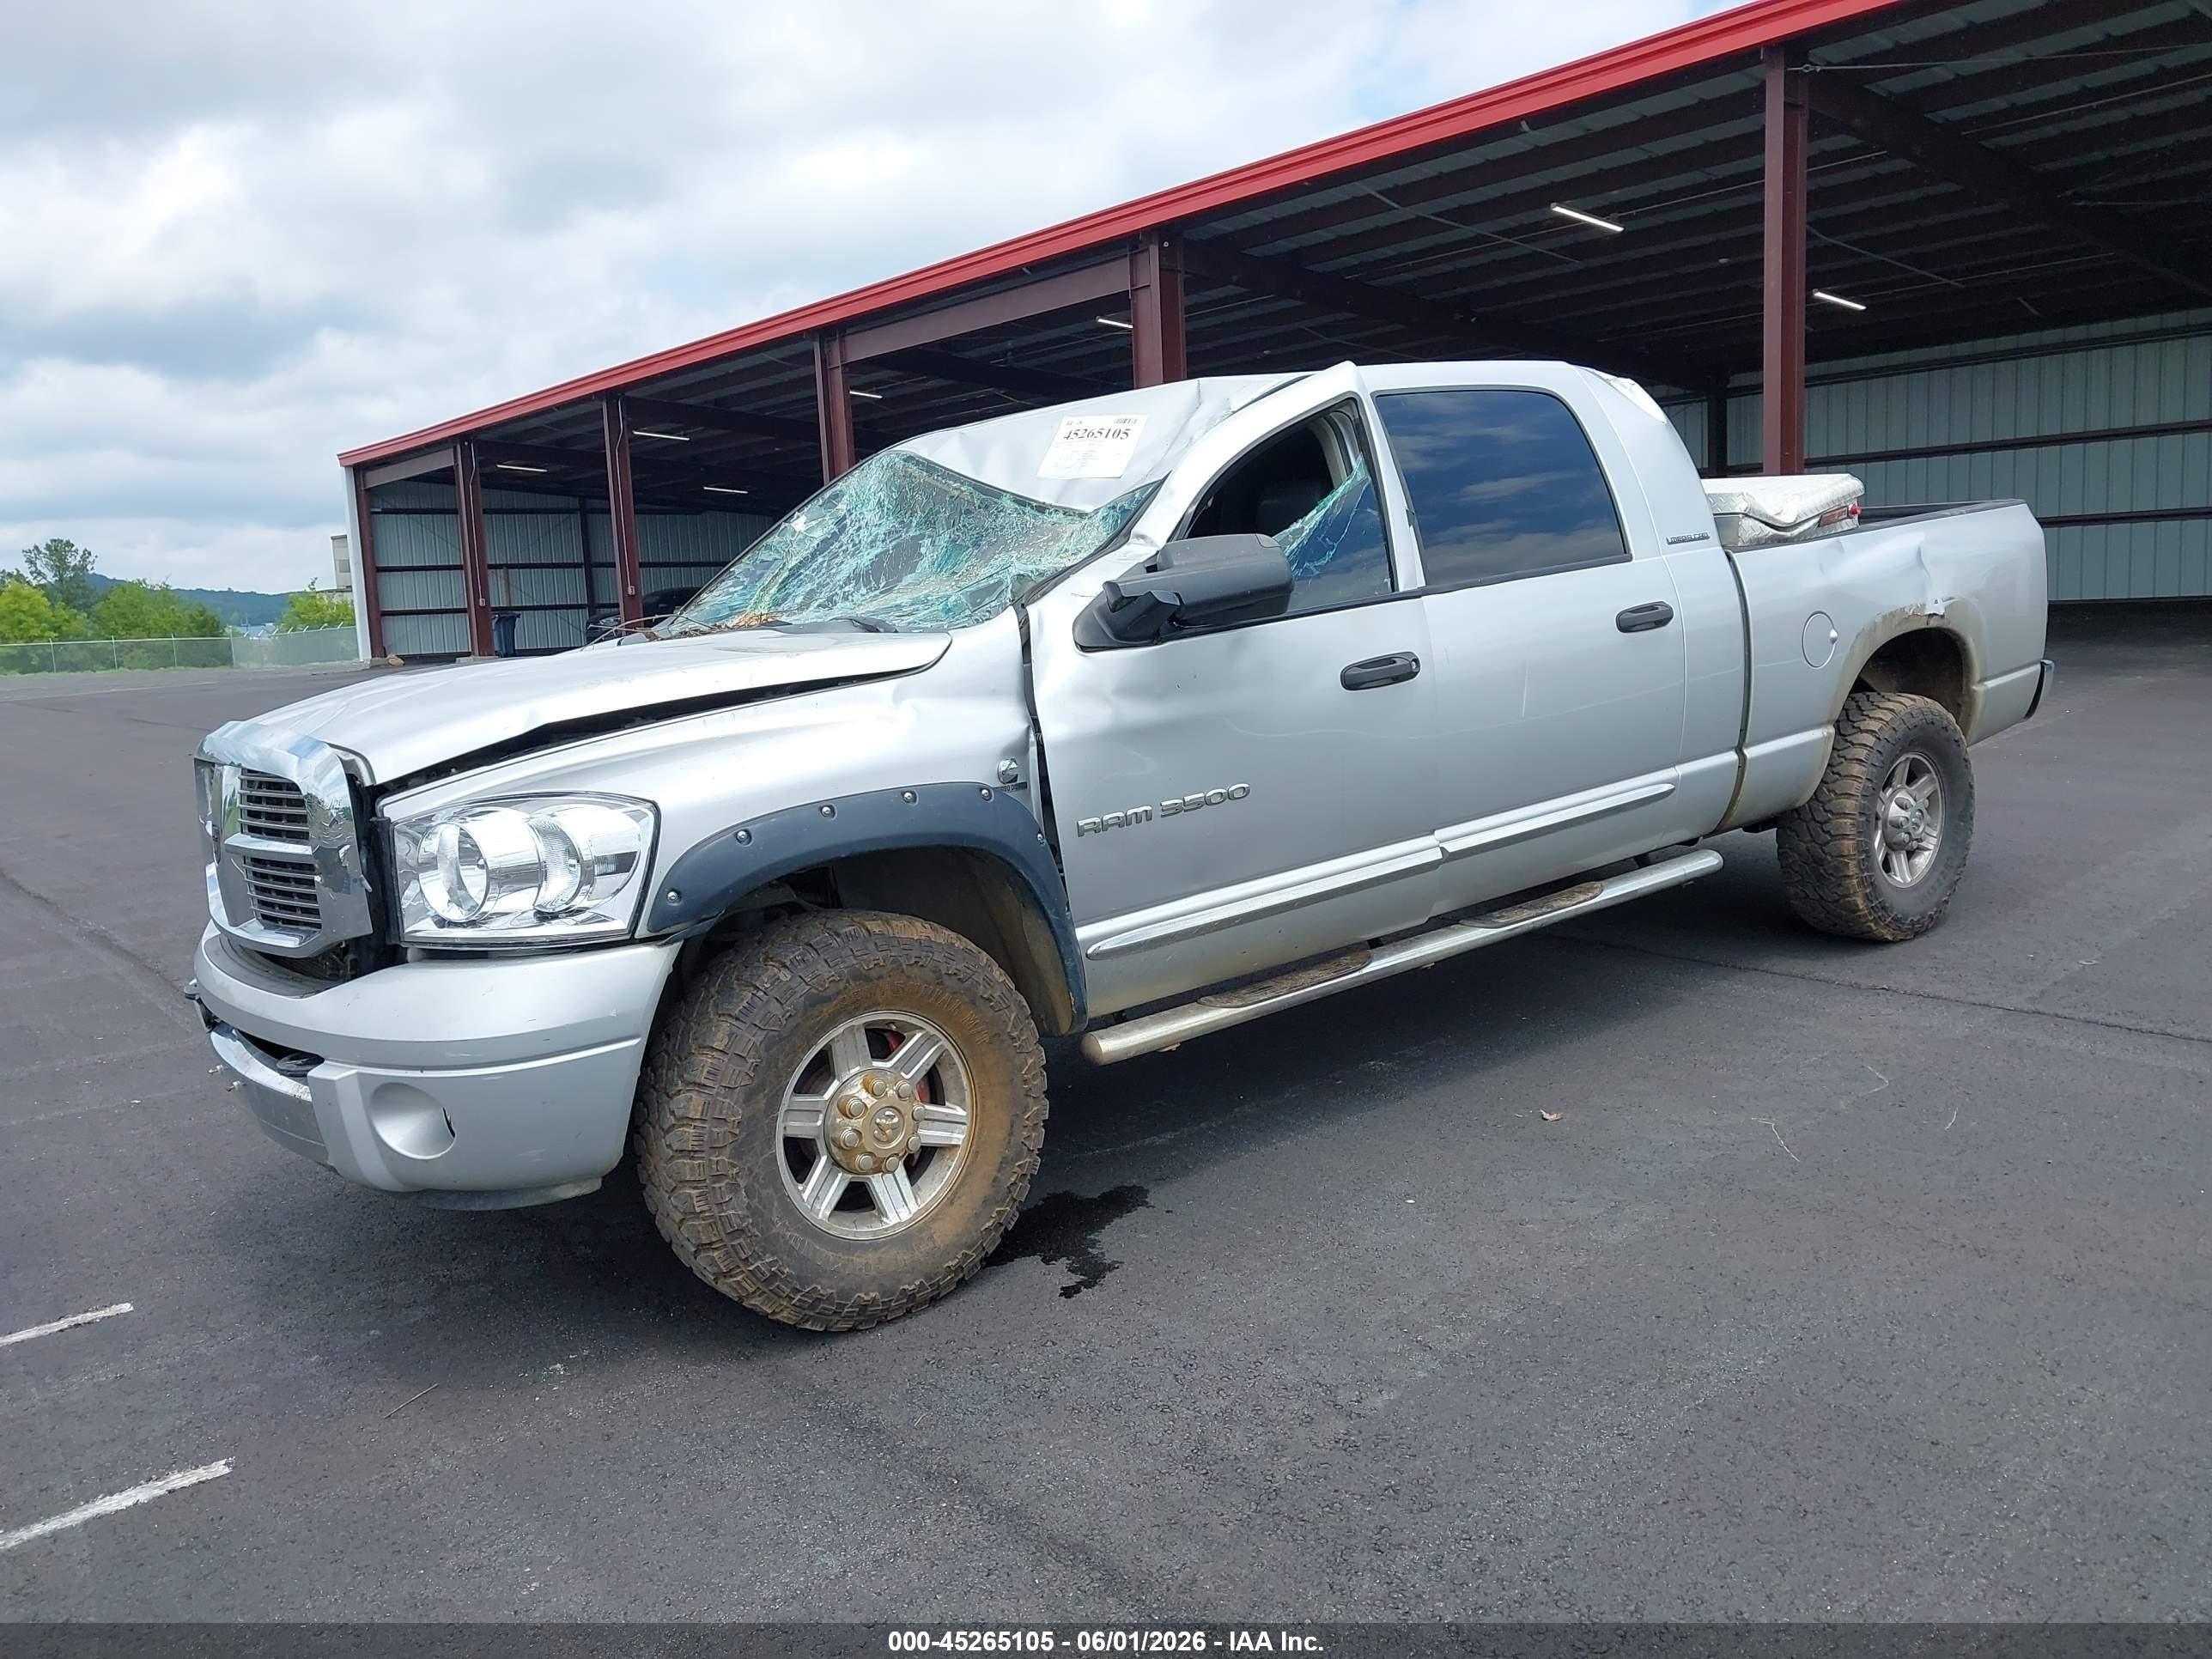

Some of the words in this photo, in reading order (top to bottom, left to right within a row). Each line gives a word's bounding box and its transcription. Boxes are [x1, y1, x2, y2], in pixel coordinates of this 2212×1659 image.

[1063, 428, 1131, 440] 45265105
[1077, 805, 1153, 837] RAM
[1160, 782, 1251, 818] 3500
